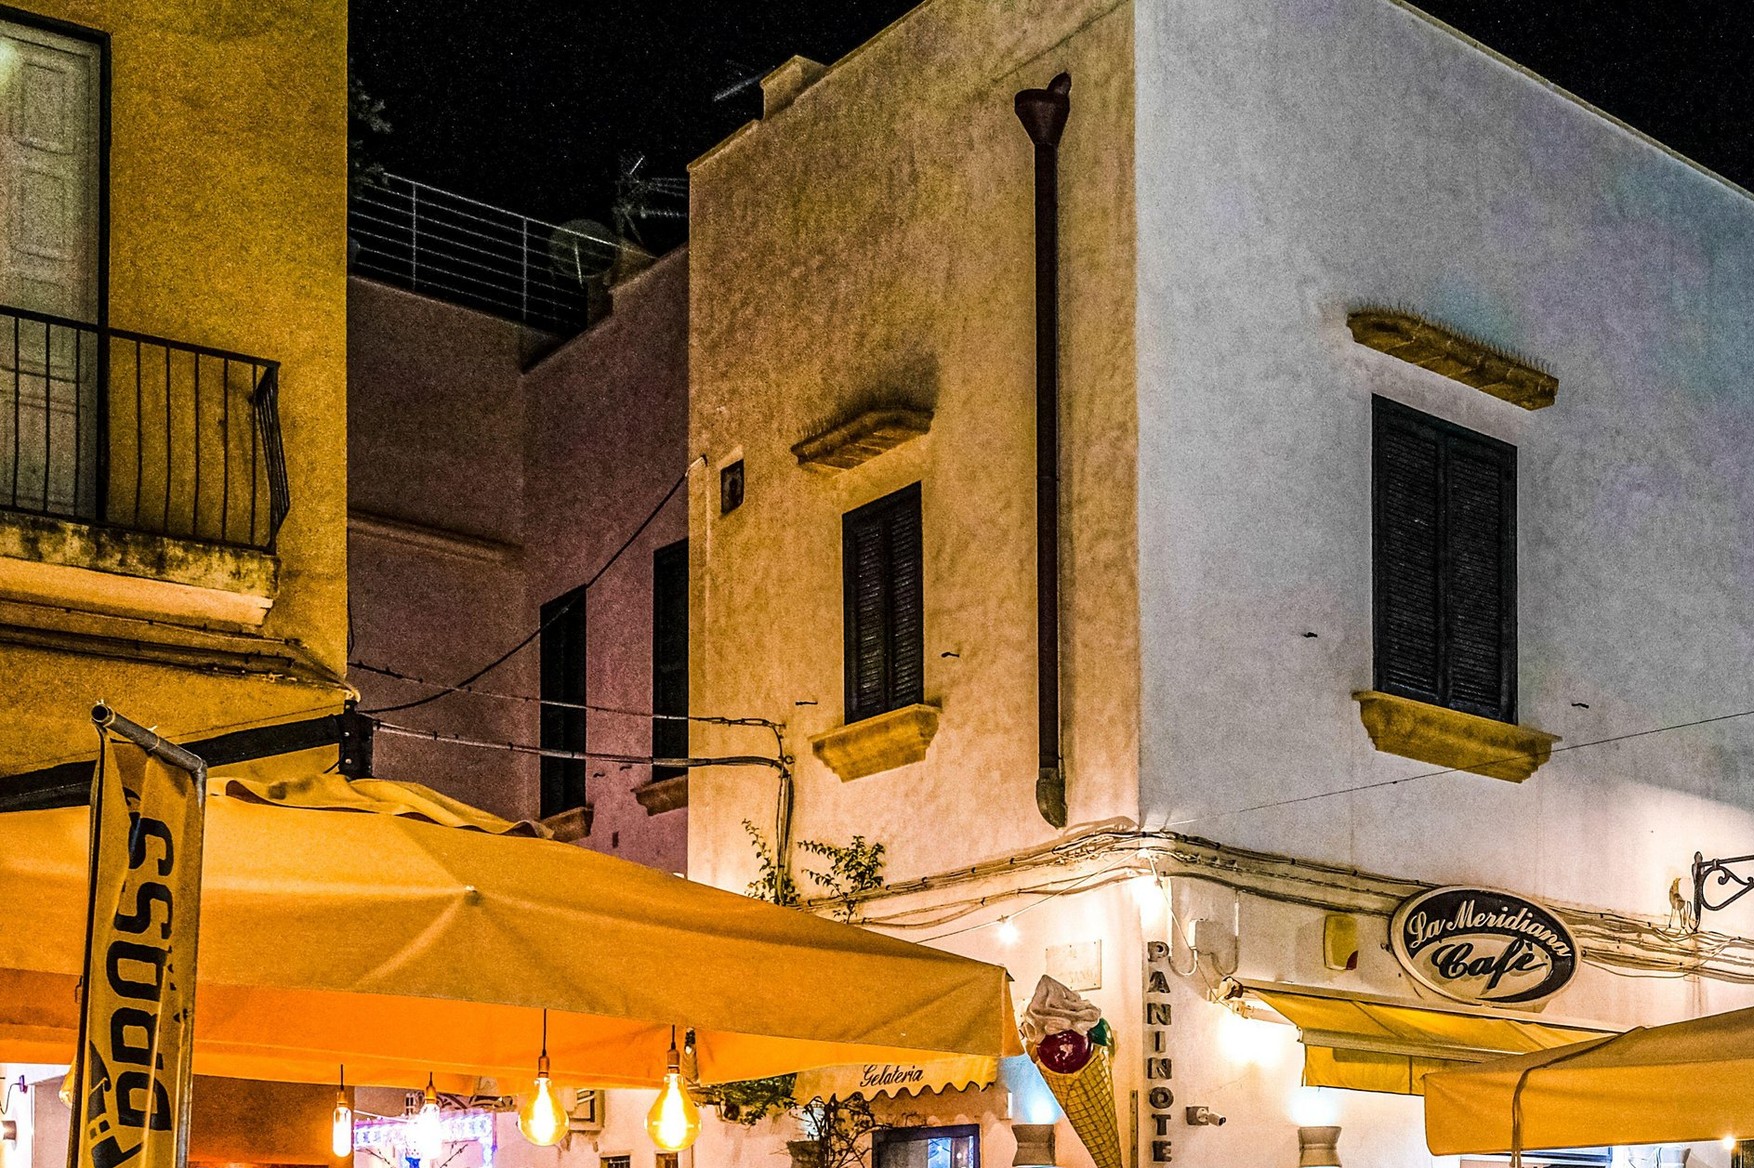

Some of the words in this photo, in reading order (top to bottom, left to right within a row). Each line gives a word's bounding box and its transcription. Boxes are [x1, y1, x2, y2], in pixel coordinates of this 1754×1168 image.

[1407, 911, 1446, 949] La
[1446, 899, 1572, 957] Meridiana
[859, 1064, 924, 1088] Gelateria
